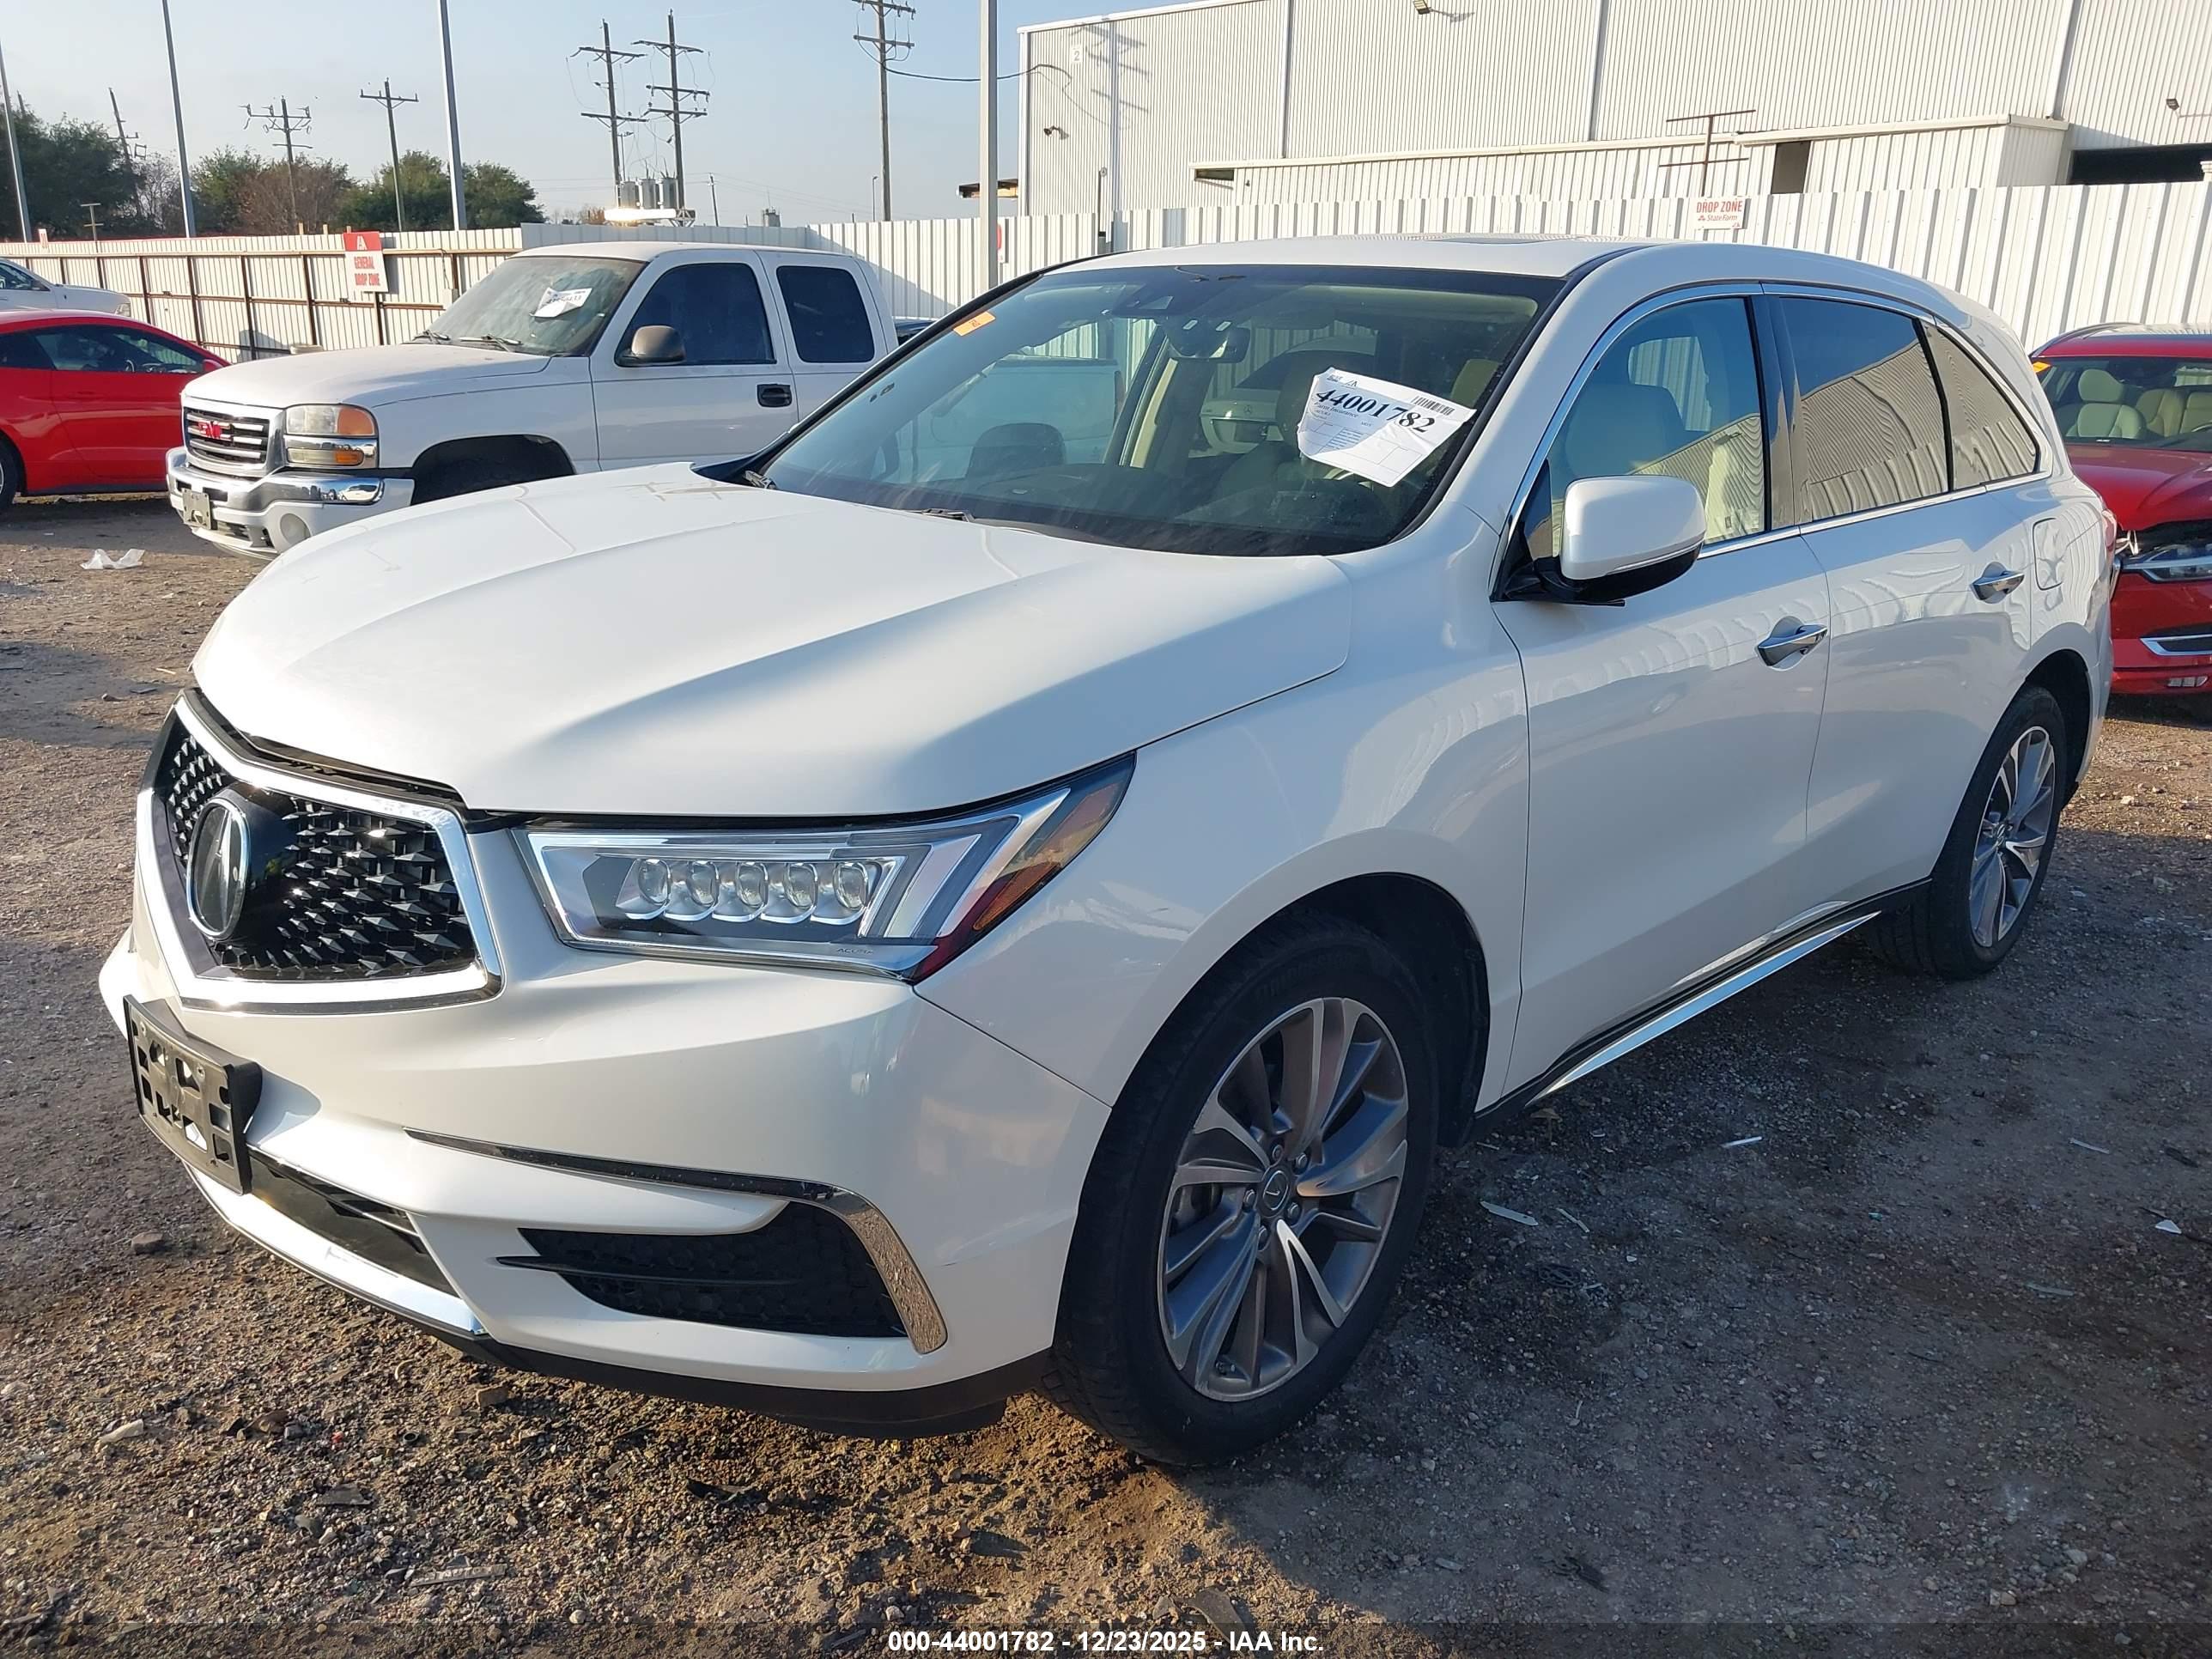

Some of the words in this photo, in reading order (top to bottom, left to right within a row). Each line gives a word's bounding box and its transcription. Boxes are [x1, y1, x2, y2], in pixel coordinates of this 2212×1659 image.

[1696, 201, 1719, 213] DROP
[1720, 200, 1743, 213] ZONE
[354, 256, 375, 269] GENERAL
[1316, 389, 1436, 433] 44001782
